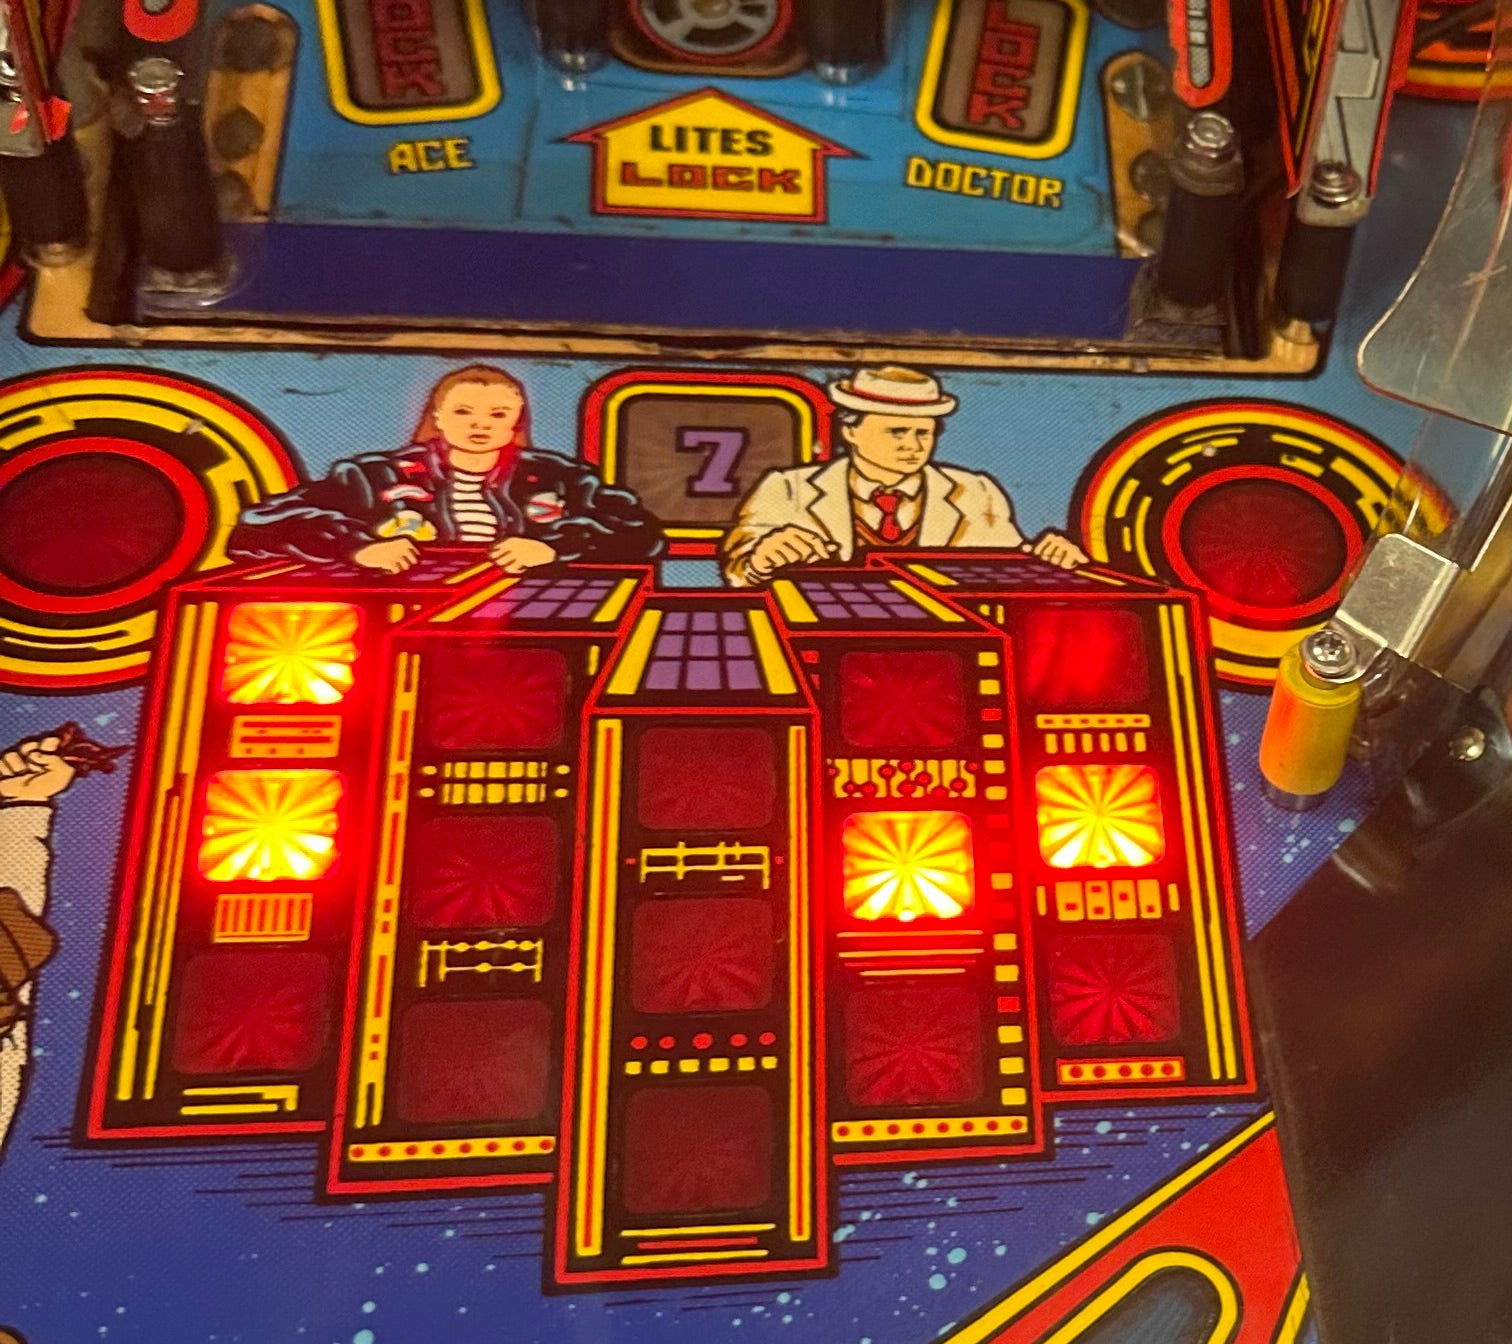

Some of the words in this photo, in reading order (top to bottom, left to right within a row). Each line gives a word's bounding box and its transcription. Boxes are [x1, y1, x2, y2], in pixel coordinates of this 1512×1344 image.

[388, 138, 476, 174] ACE
[650, 123, 773, 158] LITES
[620, 162, 803, 195] LOCK
[906, 157, 1063, 207] DOCTOR
[675, 427, 749, 497] 7
